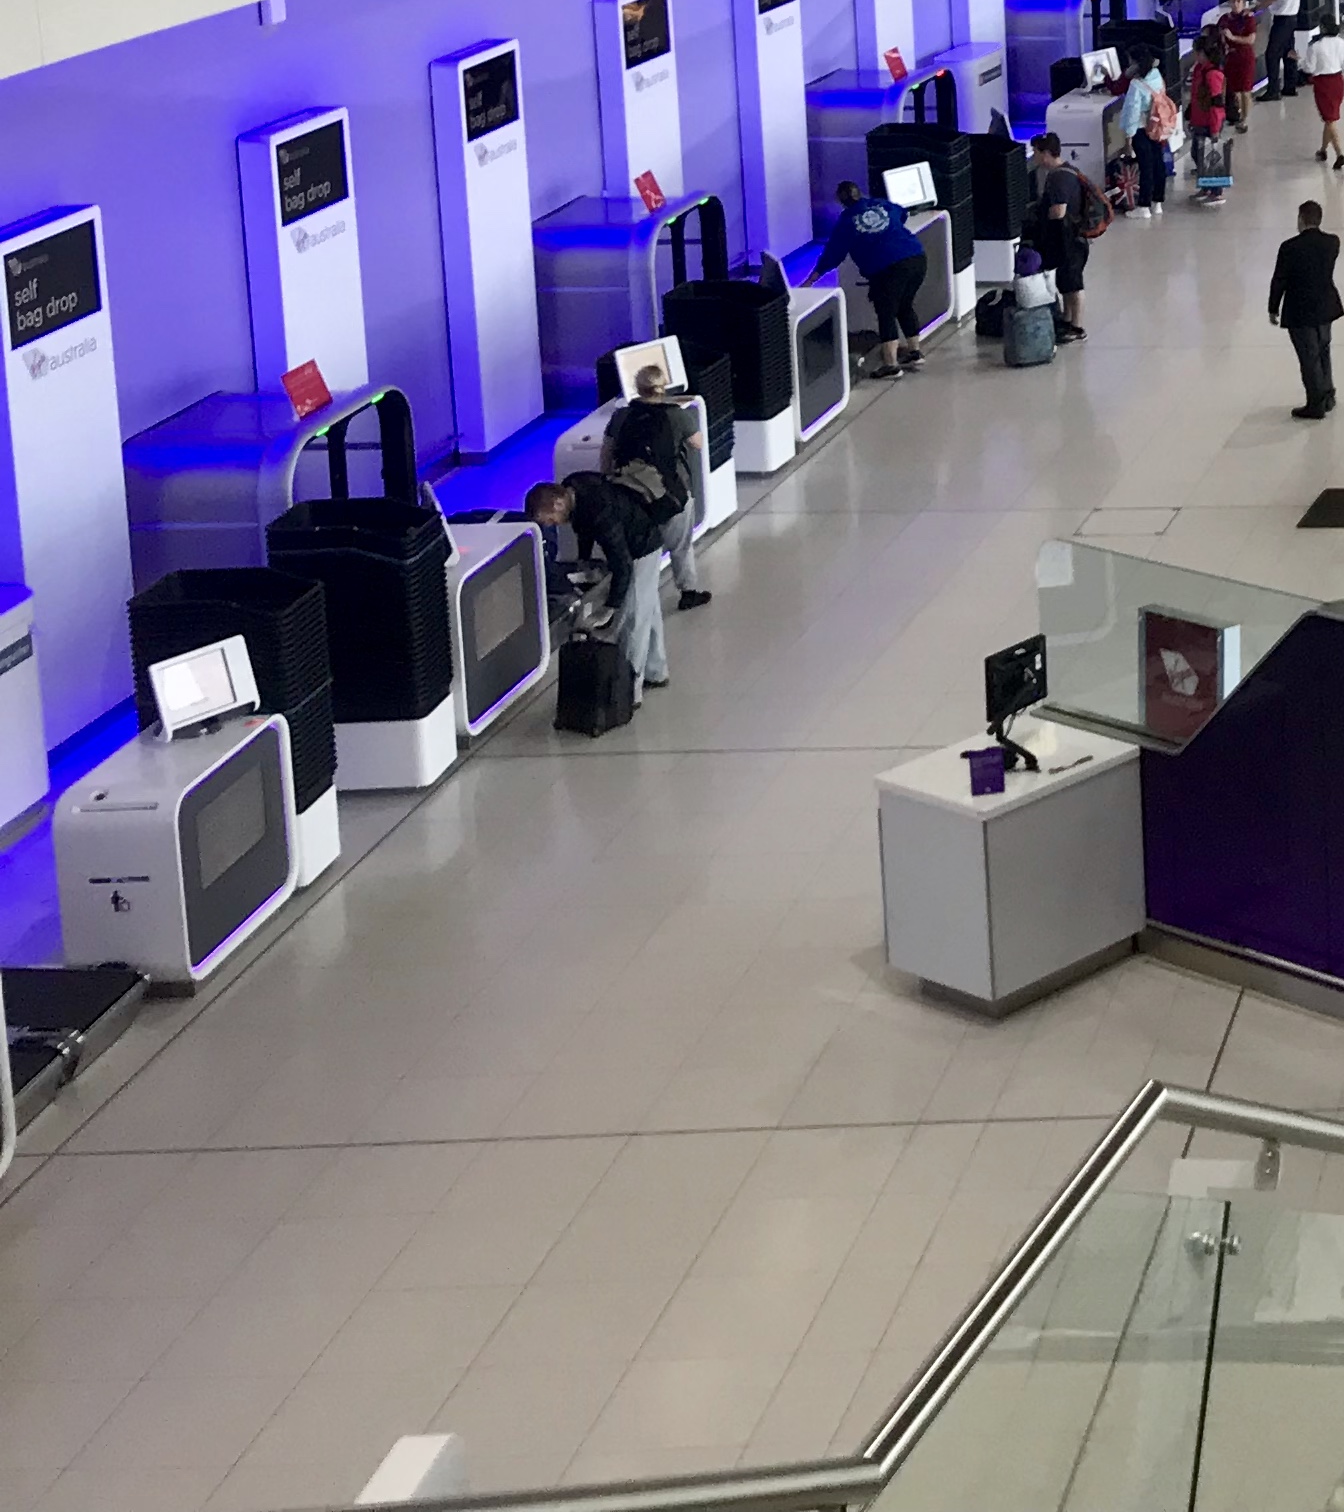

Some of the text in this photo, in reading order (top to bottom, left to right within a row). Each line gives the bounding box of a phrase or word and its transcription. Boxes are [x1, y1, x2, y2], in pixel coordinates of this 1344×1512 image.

[284, 168, 301, 191] self
[285, 181, 331, 212] bag drop
[14, 278, 38, 307] self
[16, 291, 78, 331] bag drop
[50, 337, 97, 371] australia
